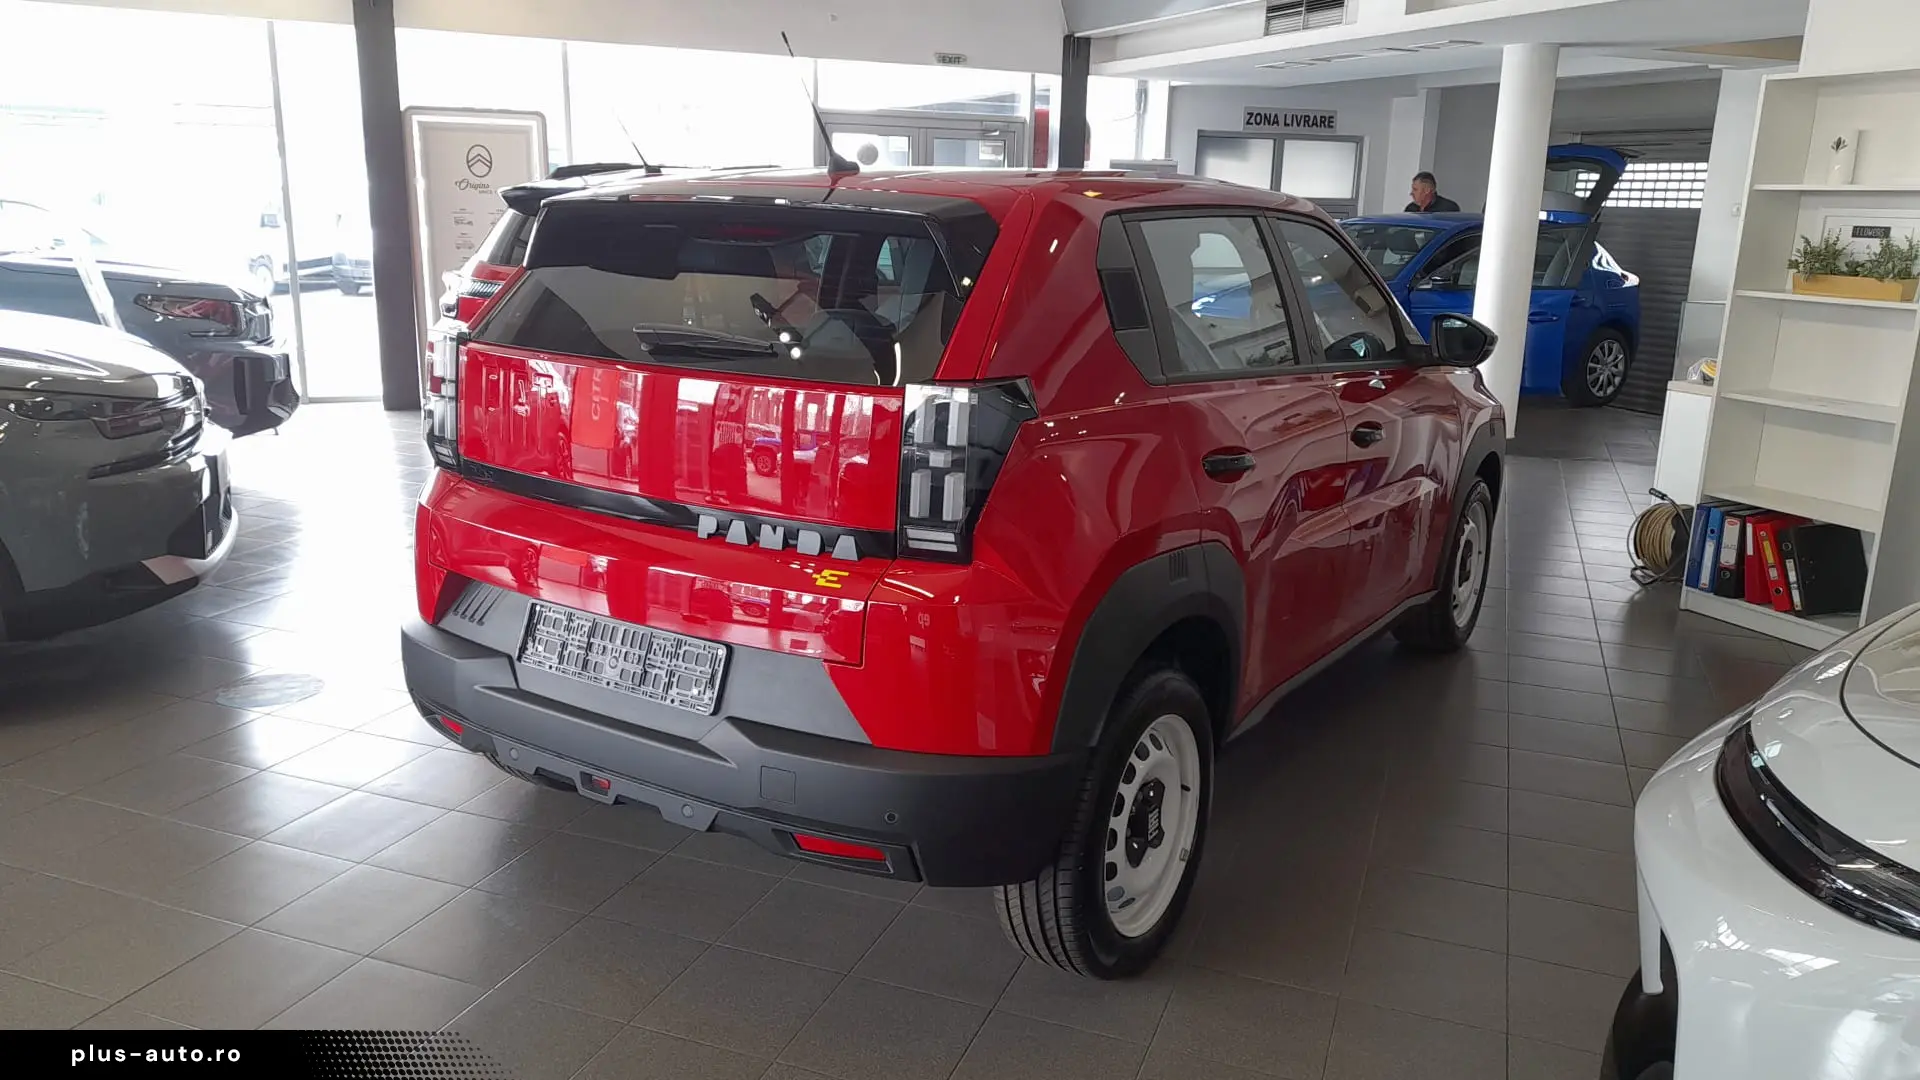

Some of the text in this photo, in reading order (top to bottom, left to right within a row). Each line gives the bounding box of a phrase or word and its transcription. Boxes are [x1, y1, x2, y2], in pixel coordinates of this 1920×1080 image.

[942, 56, 961, 65] EXIT
[1246, 112, 1335, 129] ZONA LIVRARE
[455, 178, 490, 190] Origins
[697, 514, 859, 562] PANDA
